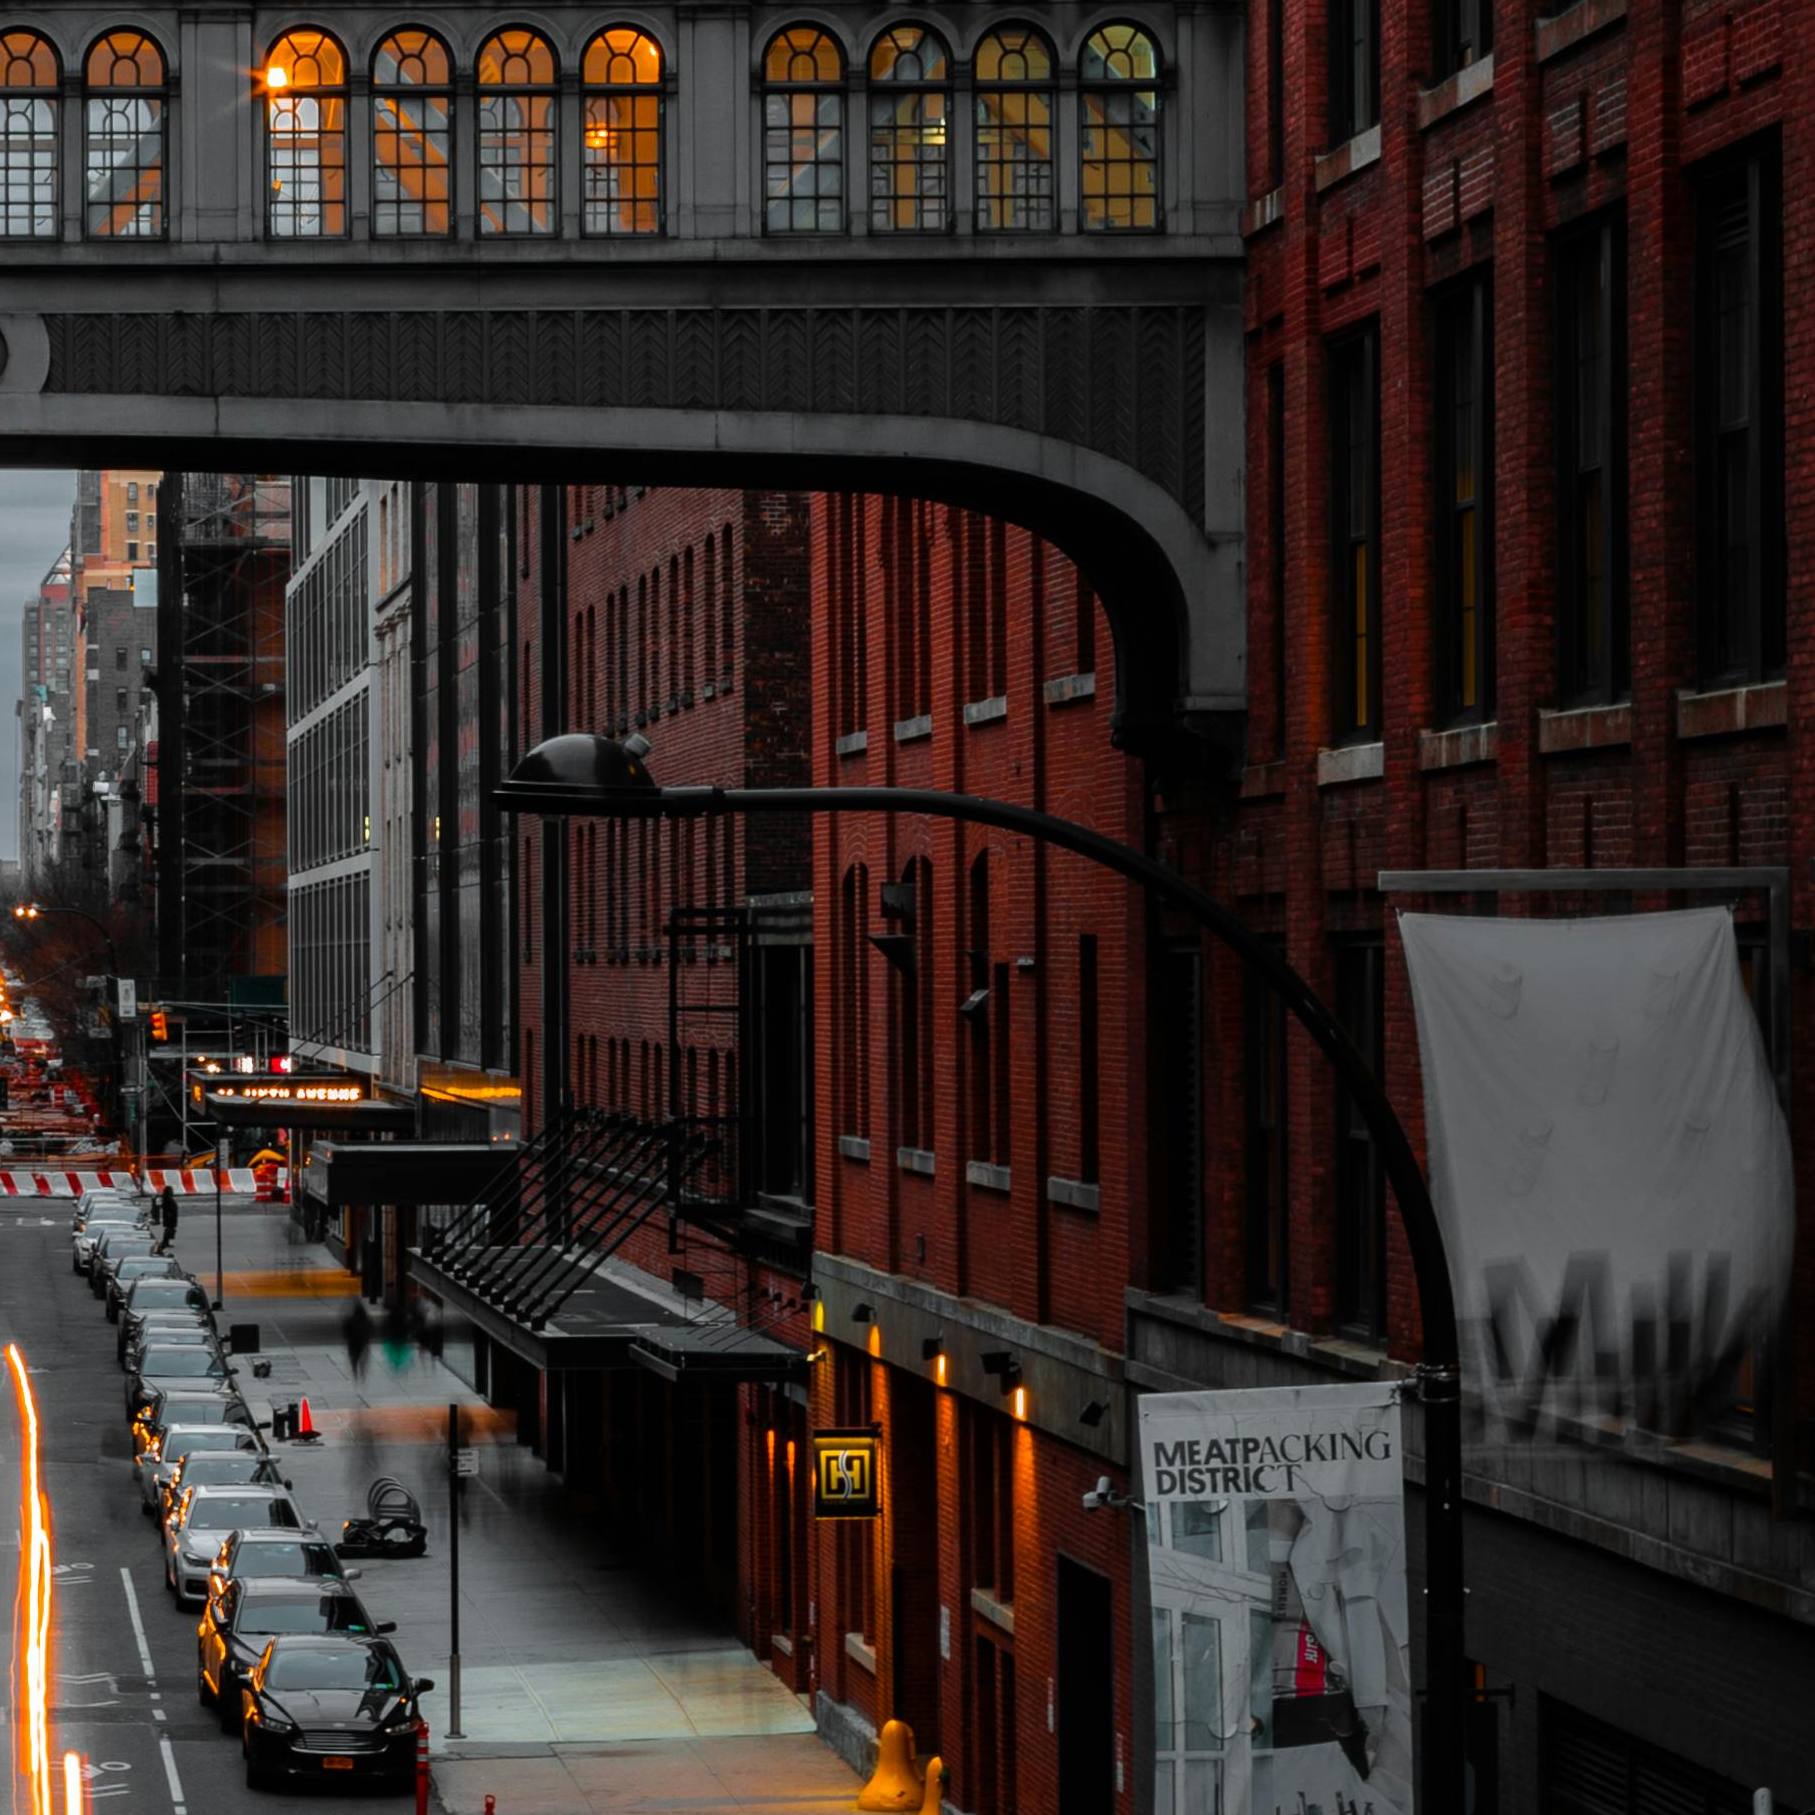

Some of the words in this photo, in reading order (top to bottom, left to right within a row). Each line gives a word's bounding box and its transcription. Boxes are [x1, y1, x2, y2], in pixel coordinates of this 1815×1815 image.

[296, 1088, 361, 1101] AVENUE
[1153, 1431, 1392, 1467] MEATPACKING
[1155, 1464, 1303, 1495] DISTRICT
